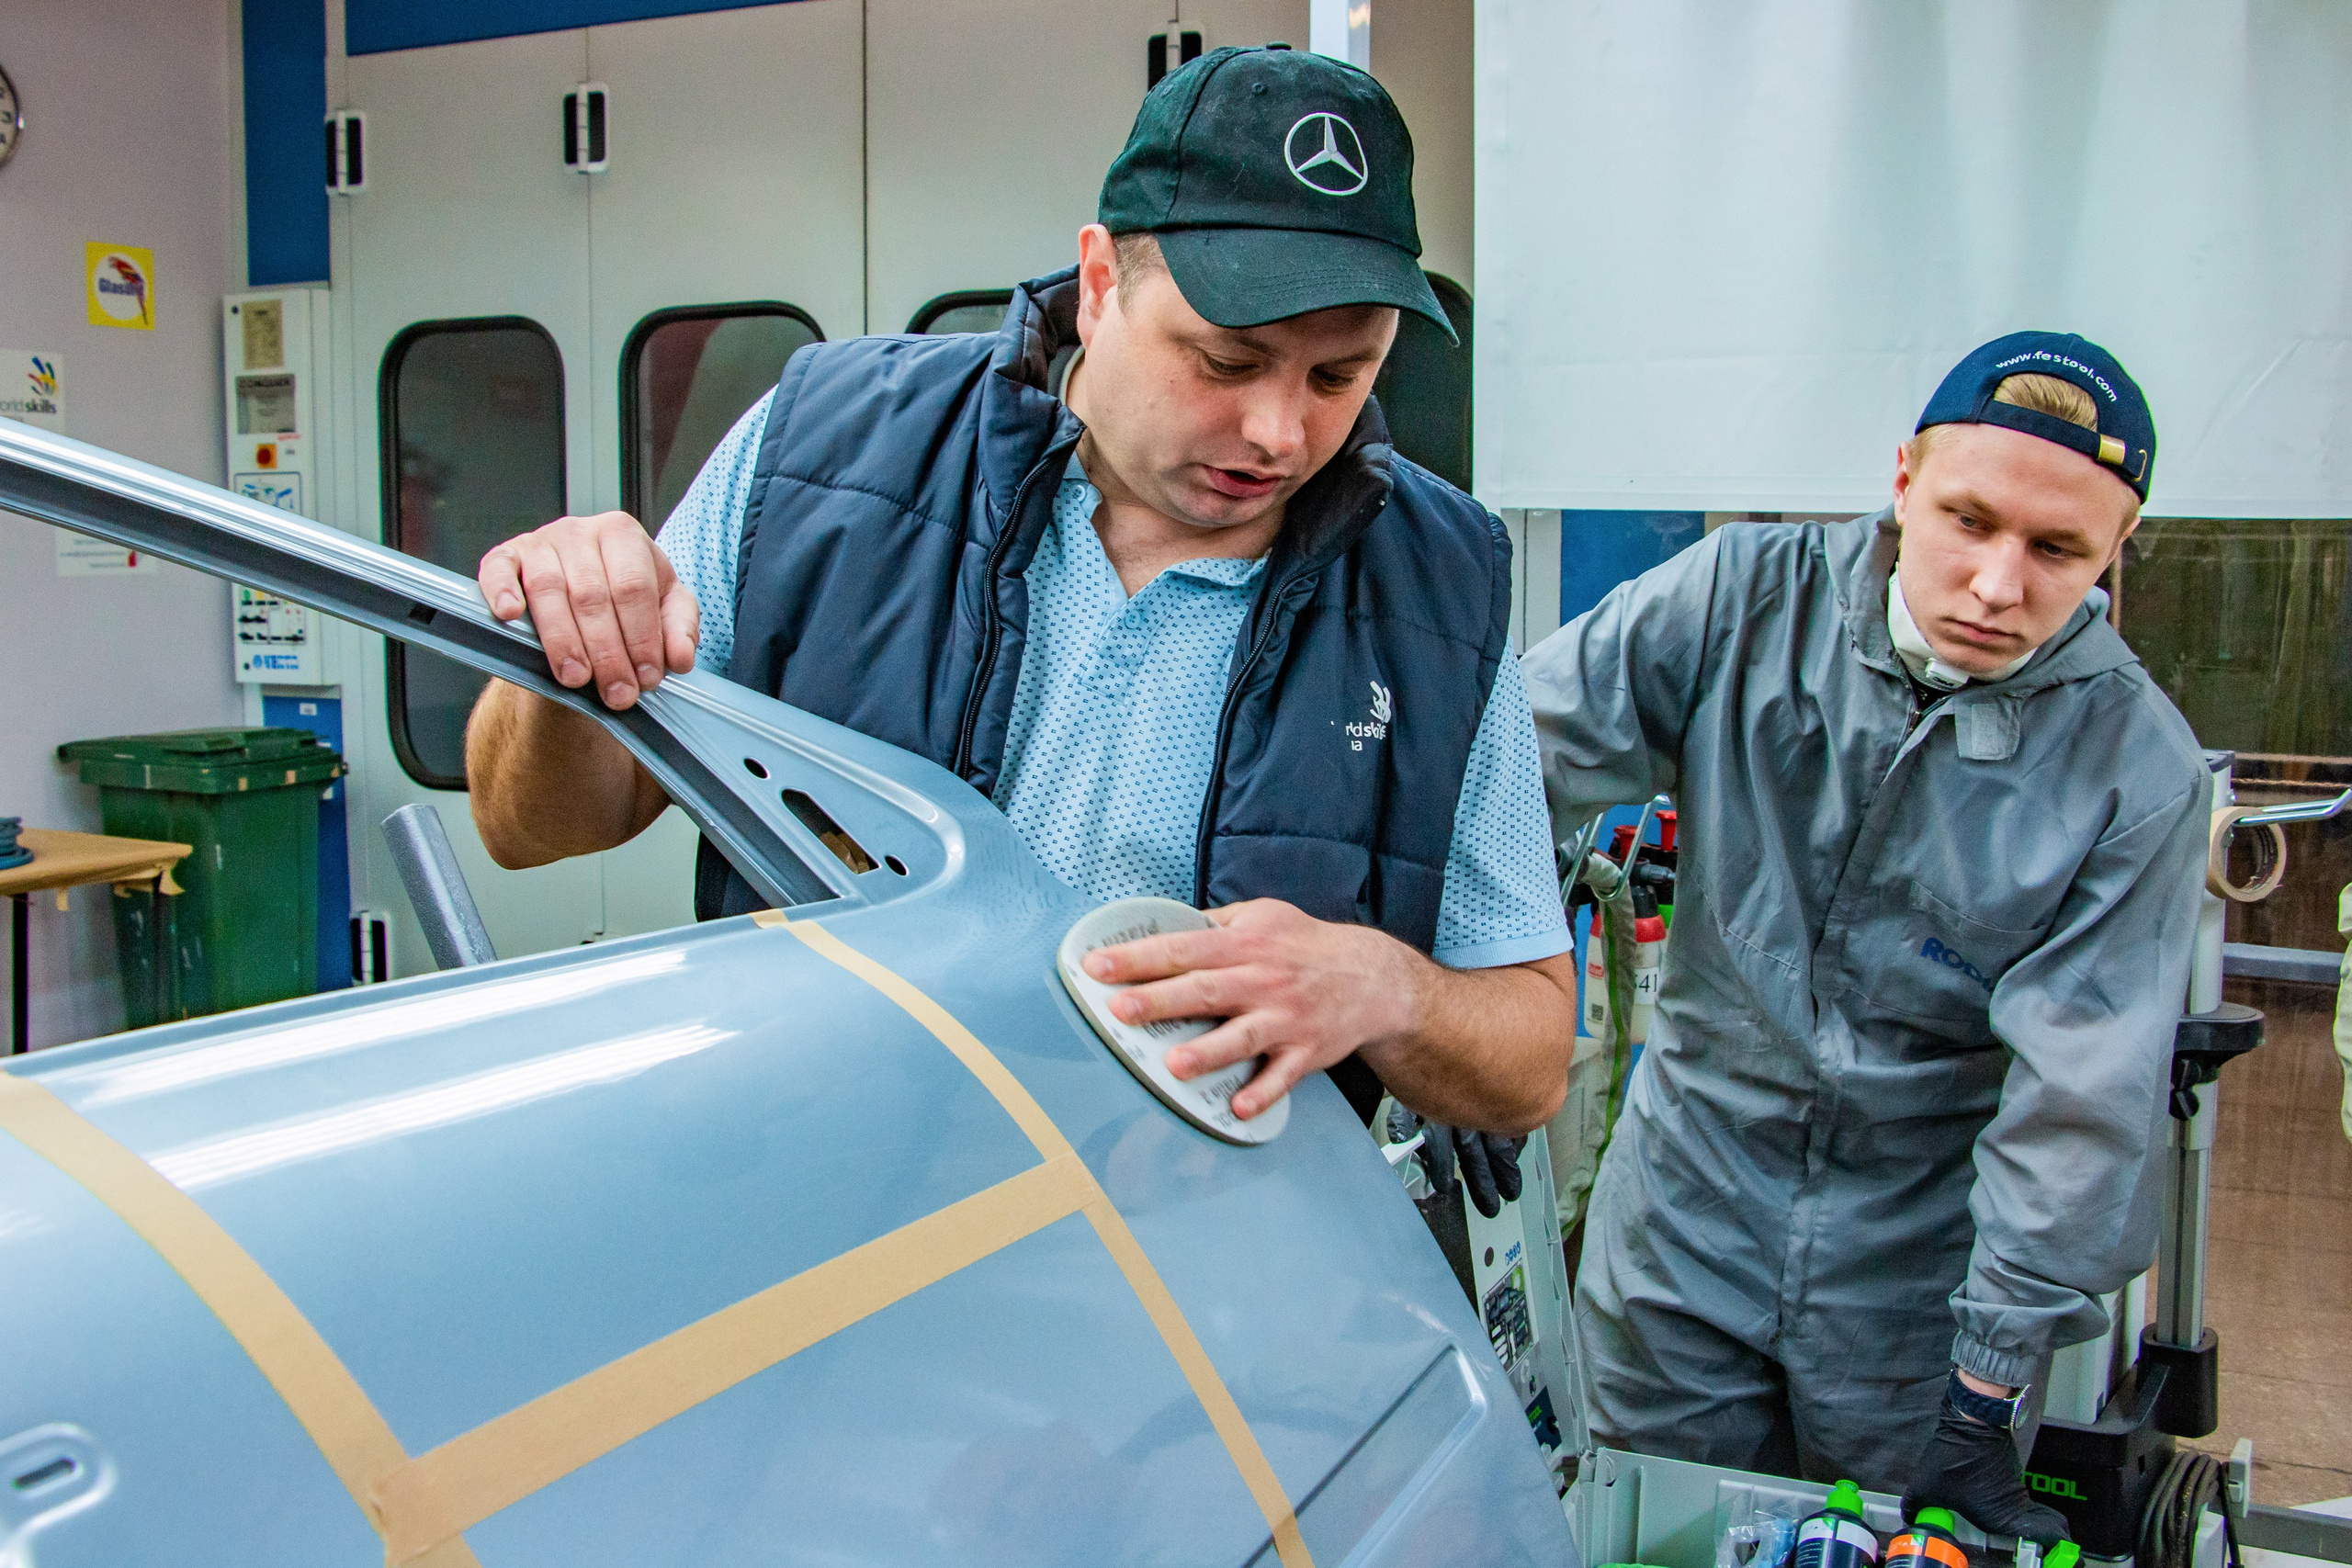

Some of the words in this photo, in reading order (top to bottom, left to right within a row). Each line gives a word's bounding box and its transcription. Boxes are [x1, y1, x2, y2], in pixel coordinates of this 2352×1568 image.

[1995, 350, 2118, 402] www.festool.com
[0, 398, 57, 415] orldskills
[2021, 1472, 2087, 1501] TOOL
